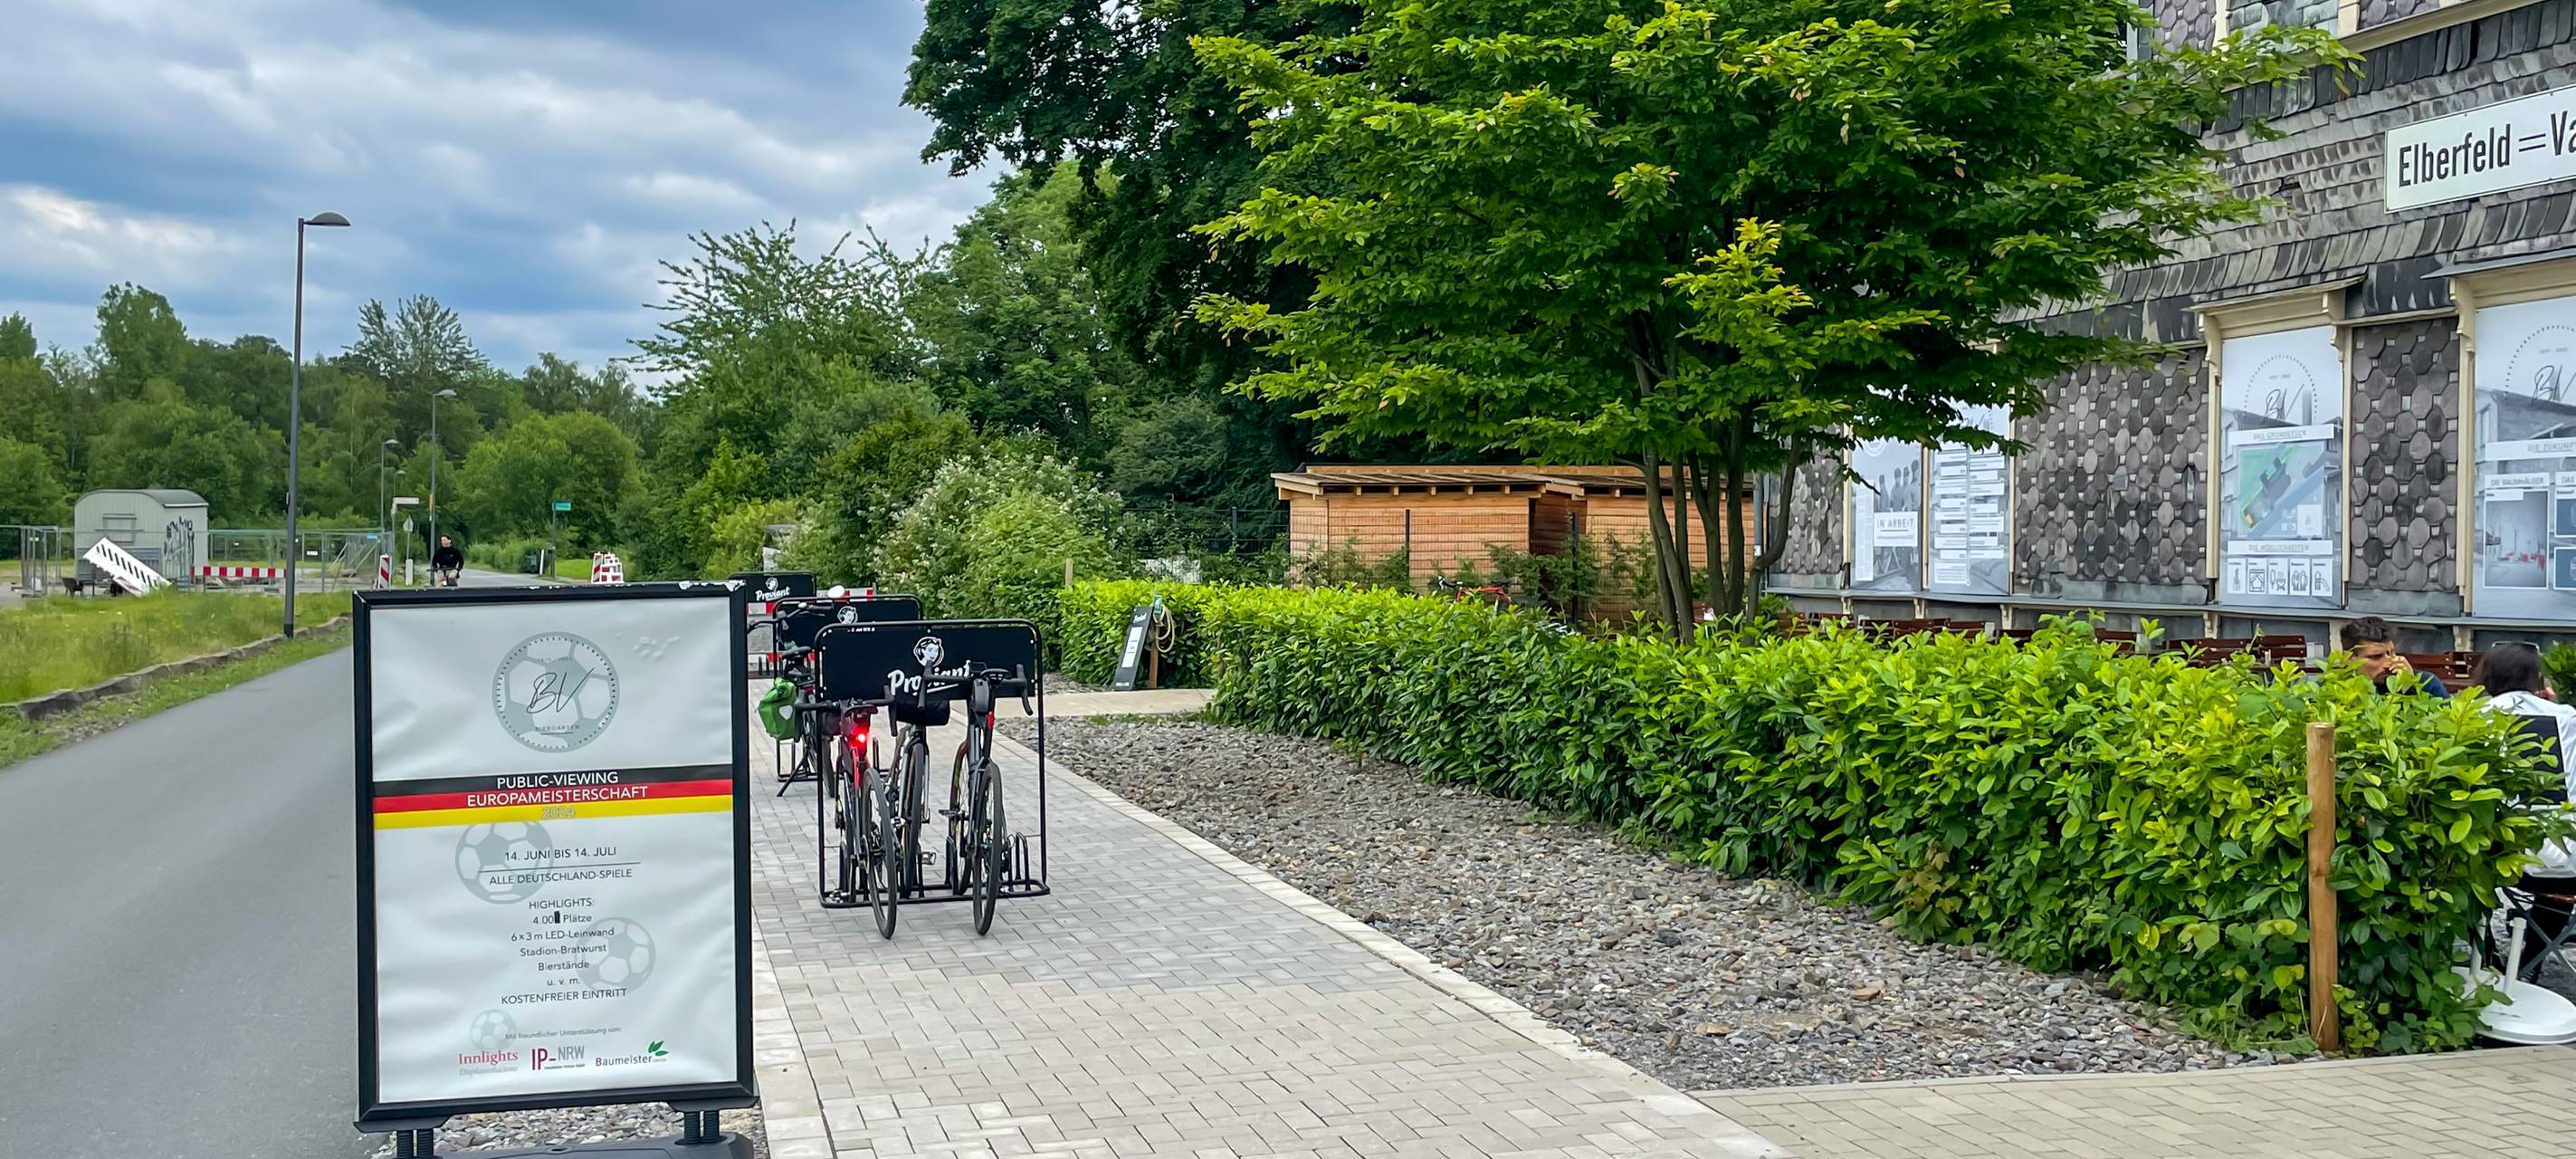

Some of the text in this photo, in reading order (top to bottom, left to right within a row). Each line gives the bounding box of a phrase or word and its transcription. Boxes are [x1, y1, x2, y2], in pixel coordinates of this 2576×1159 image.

[1887, 518, 1915, 529] ARBEIT
[755, 586, 791, 601] Proviant
[497, 771, 619, 790] PUBLIC-VIEWING
[467, 786, 648, 808] EUROPAMEISTERSCHAFT
[505, 847, 616, 861] 14. JUNI BIS 14. JULI
[489, 868, 633, 885] ALLE DEUTSCHLAND-SPIELE
[563, 913, 592, 924] Plätze
[545, 927, 615, 940] LED-Leinwand
[520, 944, 607, 957] Stadion-Bratwurst
[538, 960, 590, 972] Bierstände
[501, 988, 628, 1005] KOSTENFREIER EINTRITT
[458, 1049, 519, 1066] Innlights
[596, 1054, 653, 1067] Baumeister
